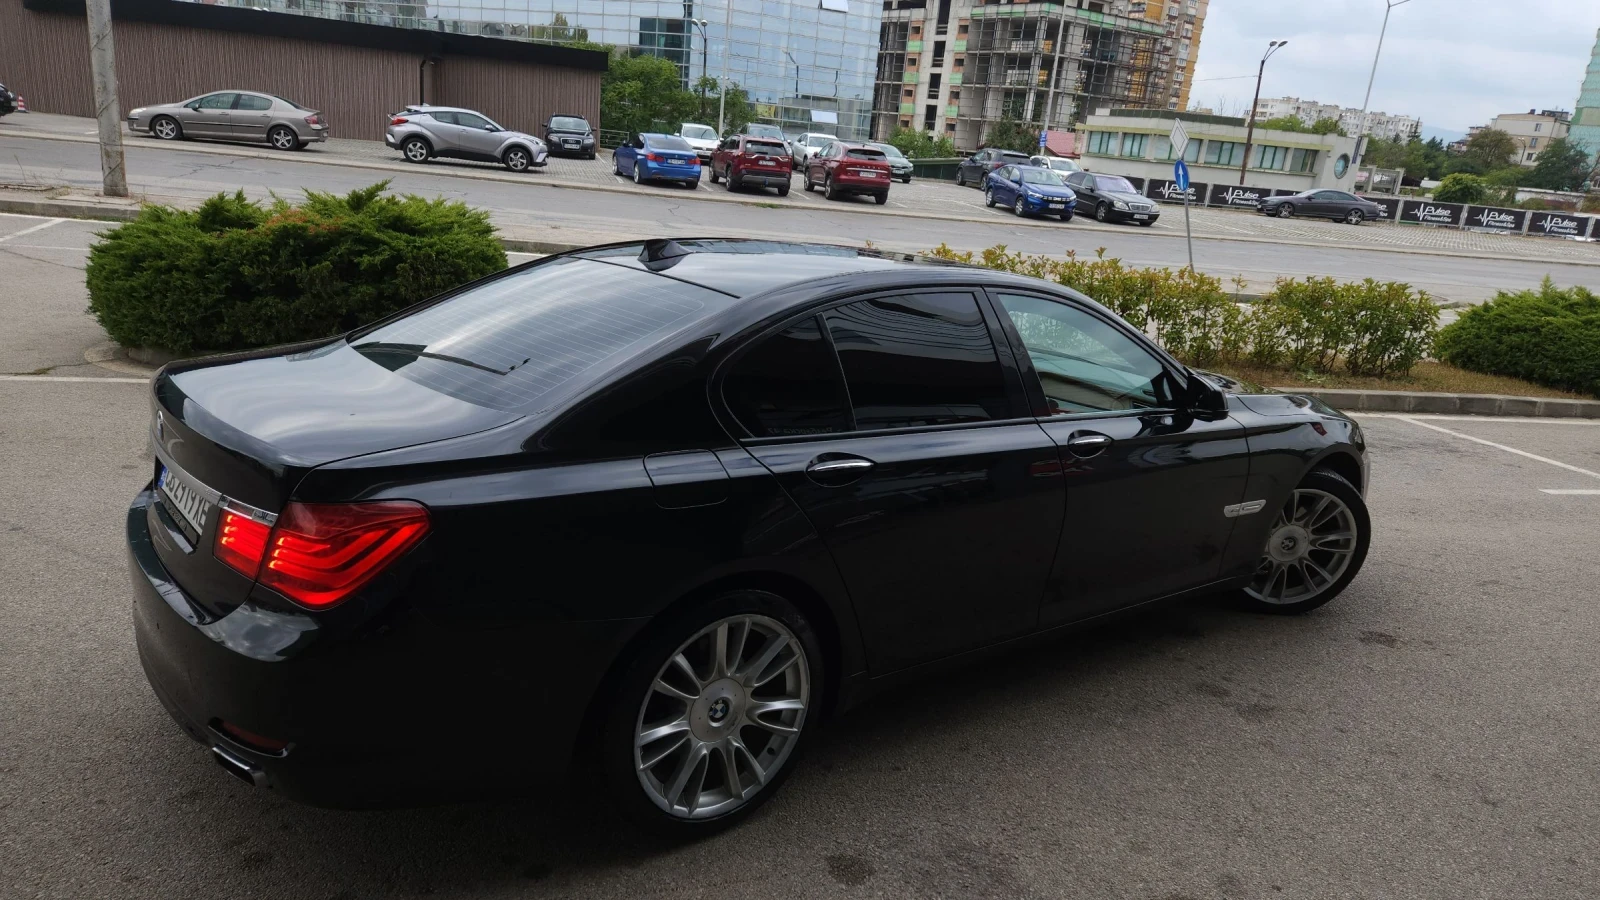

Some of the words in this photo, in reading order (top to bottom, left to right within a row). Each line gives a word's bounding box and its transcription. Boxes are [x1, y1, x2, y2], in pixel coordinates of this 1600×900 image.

[1233, 190, 1259, 198] Pulse
[1424, 206, 1451, 215] Pulse
[1489, 211, 1514, 221] Pulse
[1551, 217, 1577, 227] Pulse
